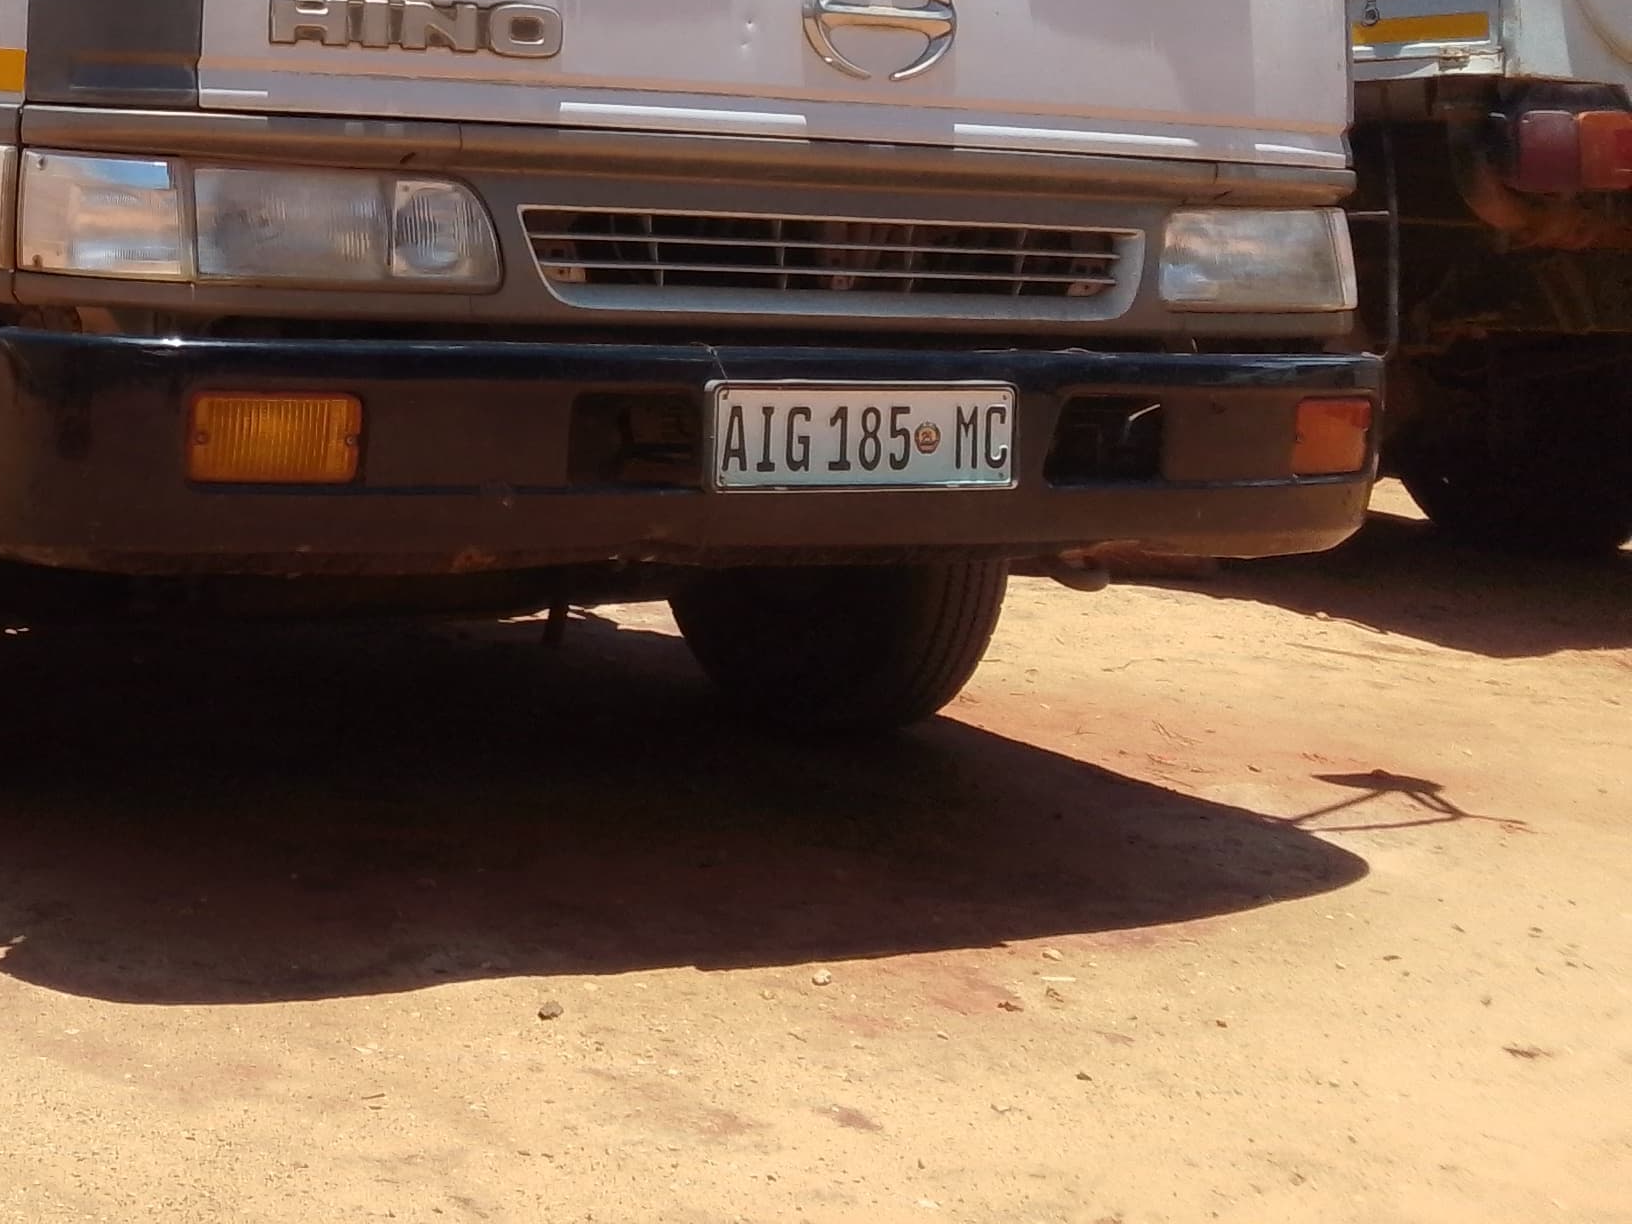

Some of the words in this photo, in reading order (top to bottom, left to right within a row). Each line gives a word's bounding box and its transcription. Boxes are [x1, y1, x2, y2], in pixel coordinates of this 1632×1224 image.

[721, 405, 812, 472] AIG
[827, 405, 912, 471] 185
[954, 405, 1008, 470] MC
